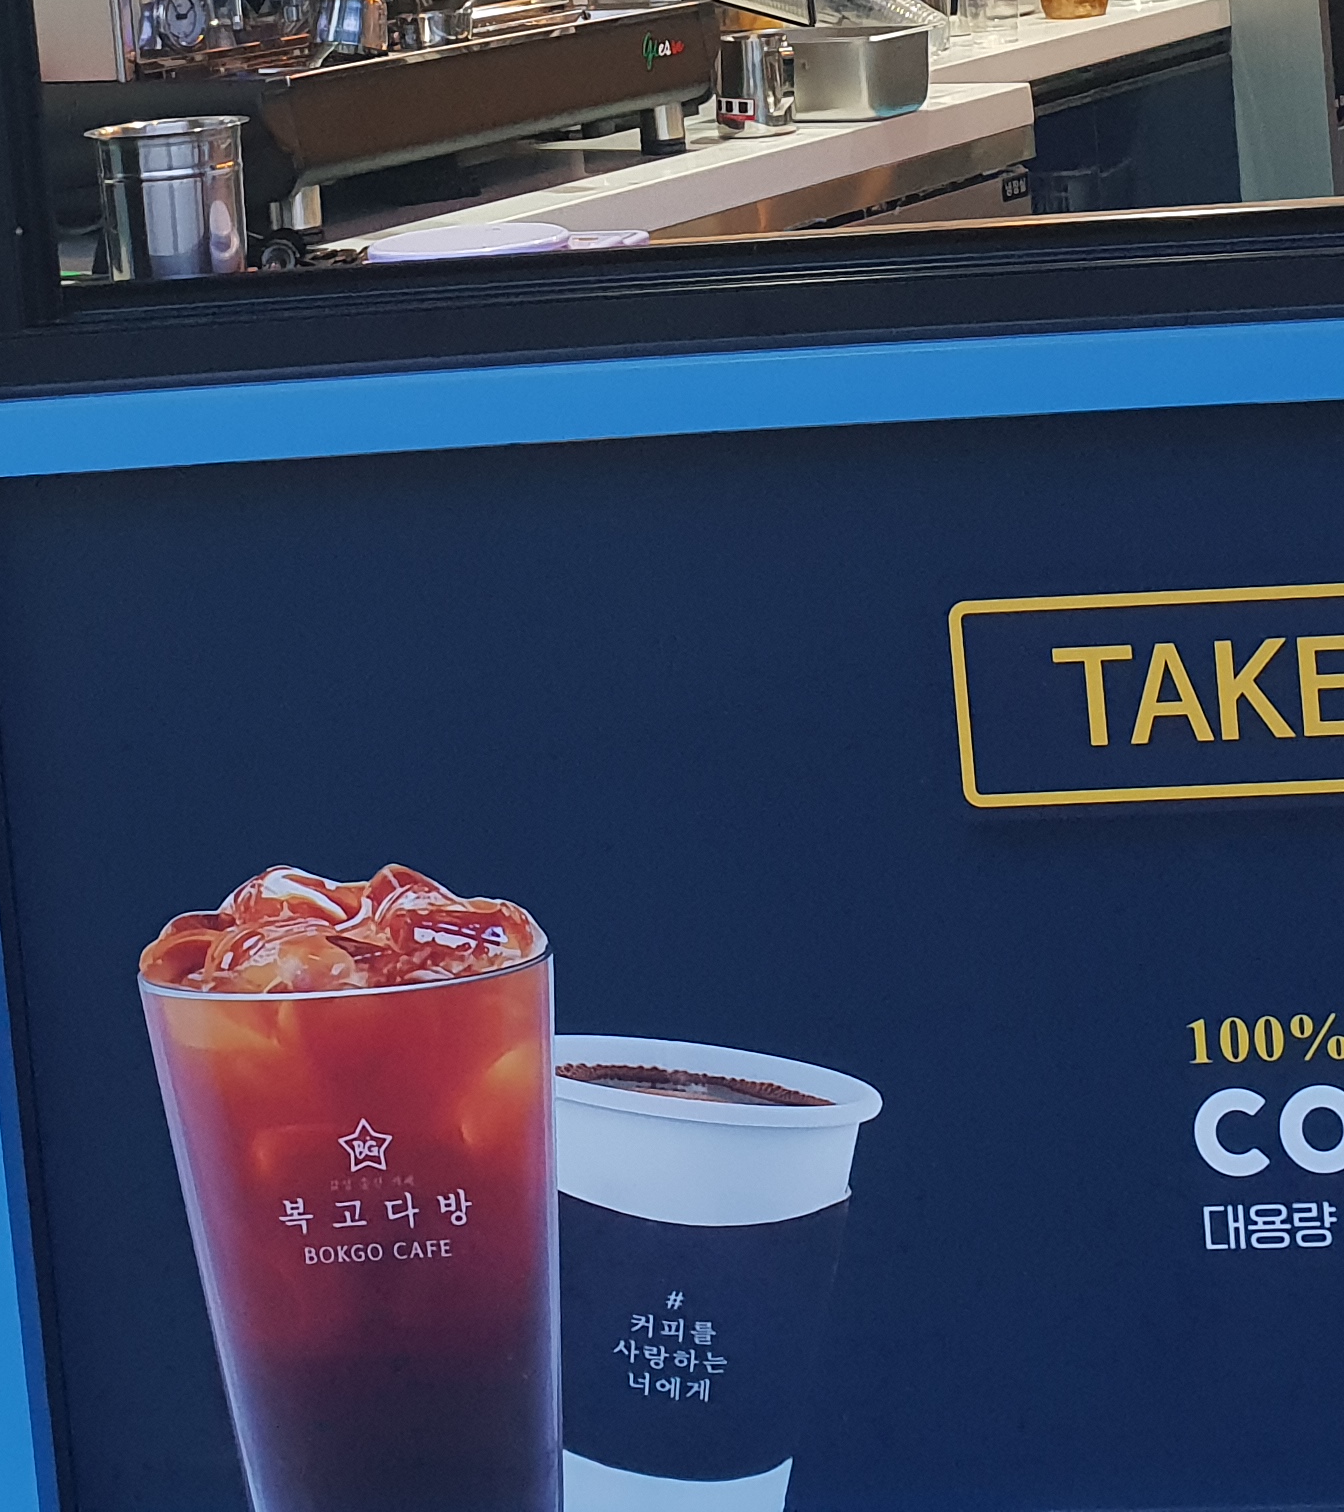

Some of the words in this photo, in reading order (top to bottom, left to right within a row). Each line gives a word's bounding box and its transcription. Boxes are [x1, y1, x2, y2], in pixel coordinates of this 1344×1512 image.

[355, 1135, 380, 1160] BG
[1201, 1199, 1338, 1253] 대용량
[304, 1243, 384, 1266] BOKGO
[393, 1238, 453, 1261] CAFE
[665, 1290, 685, 1311] #
[630, 1313, 717, 1346] 커피를
[613, 1338, 728, 1375] 사랑하는
[628, 1370, 711, 1403] 너에게
